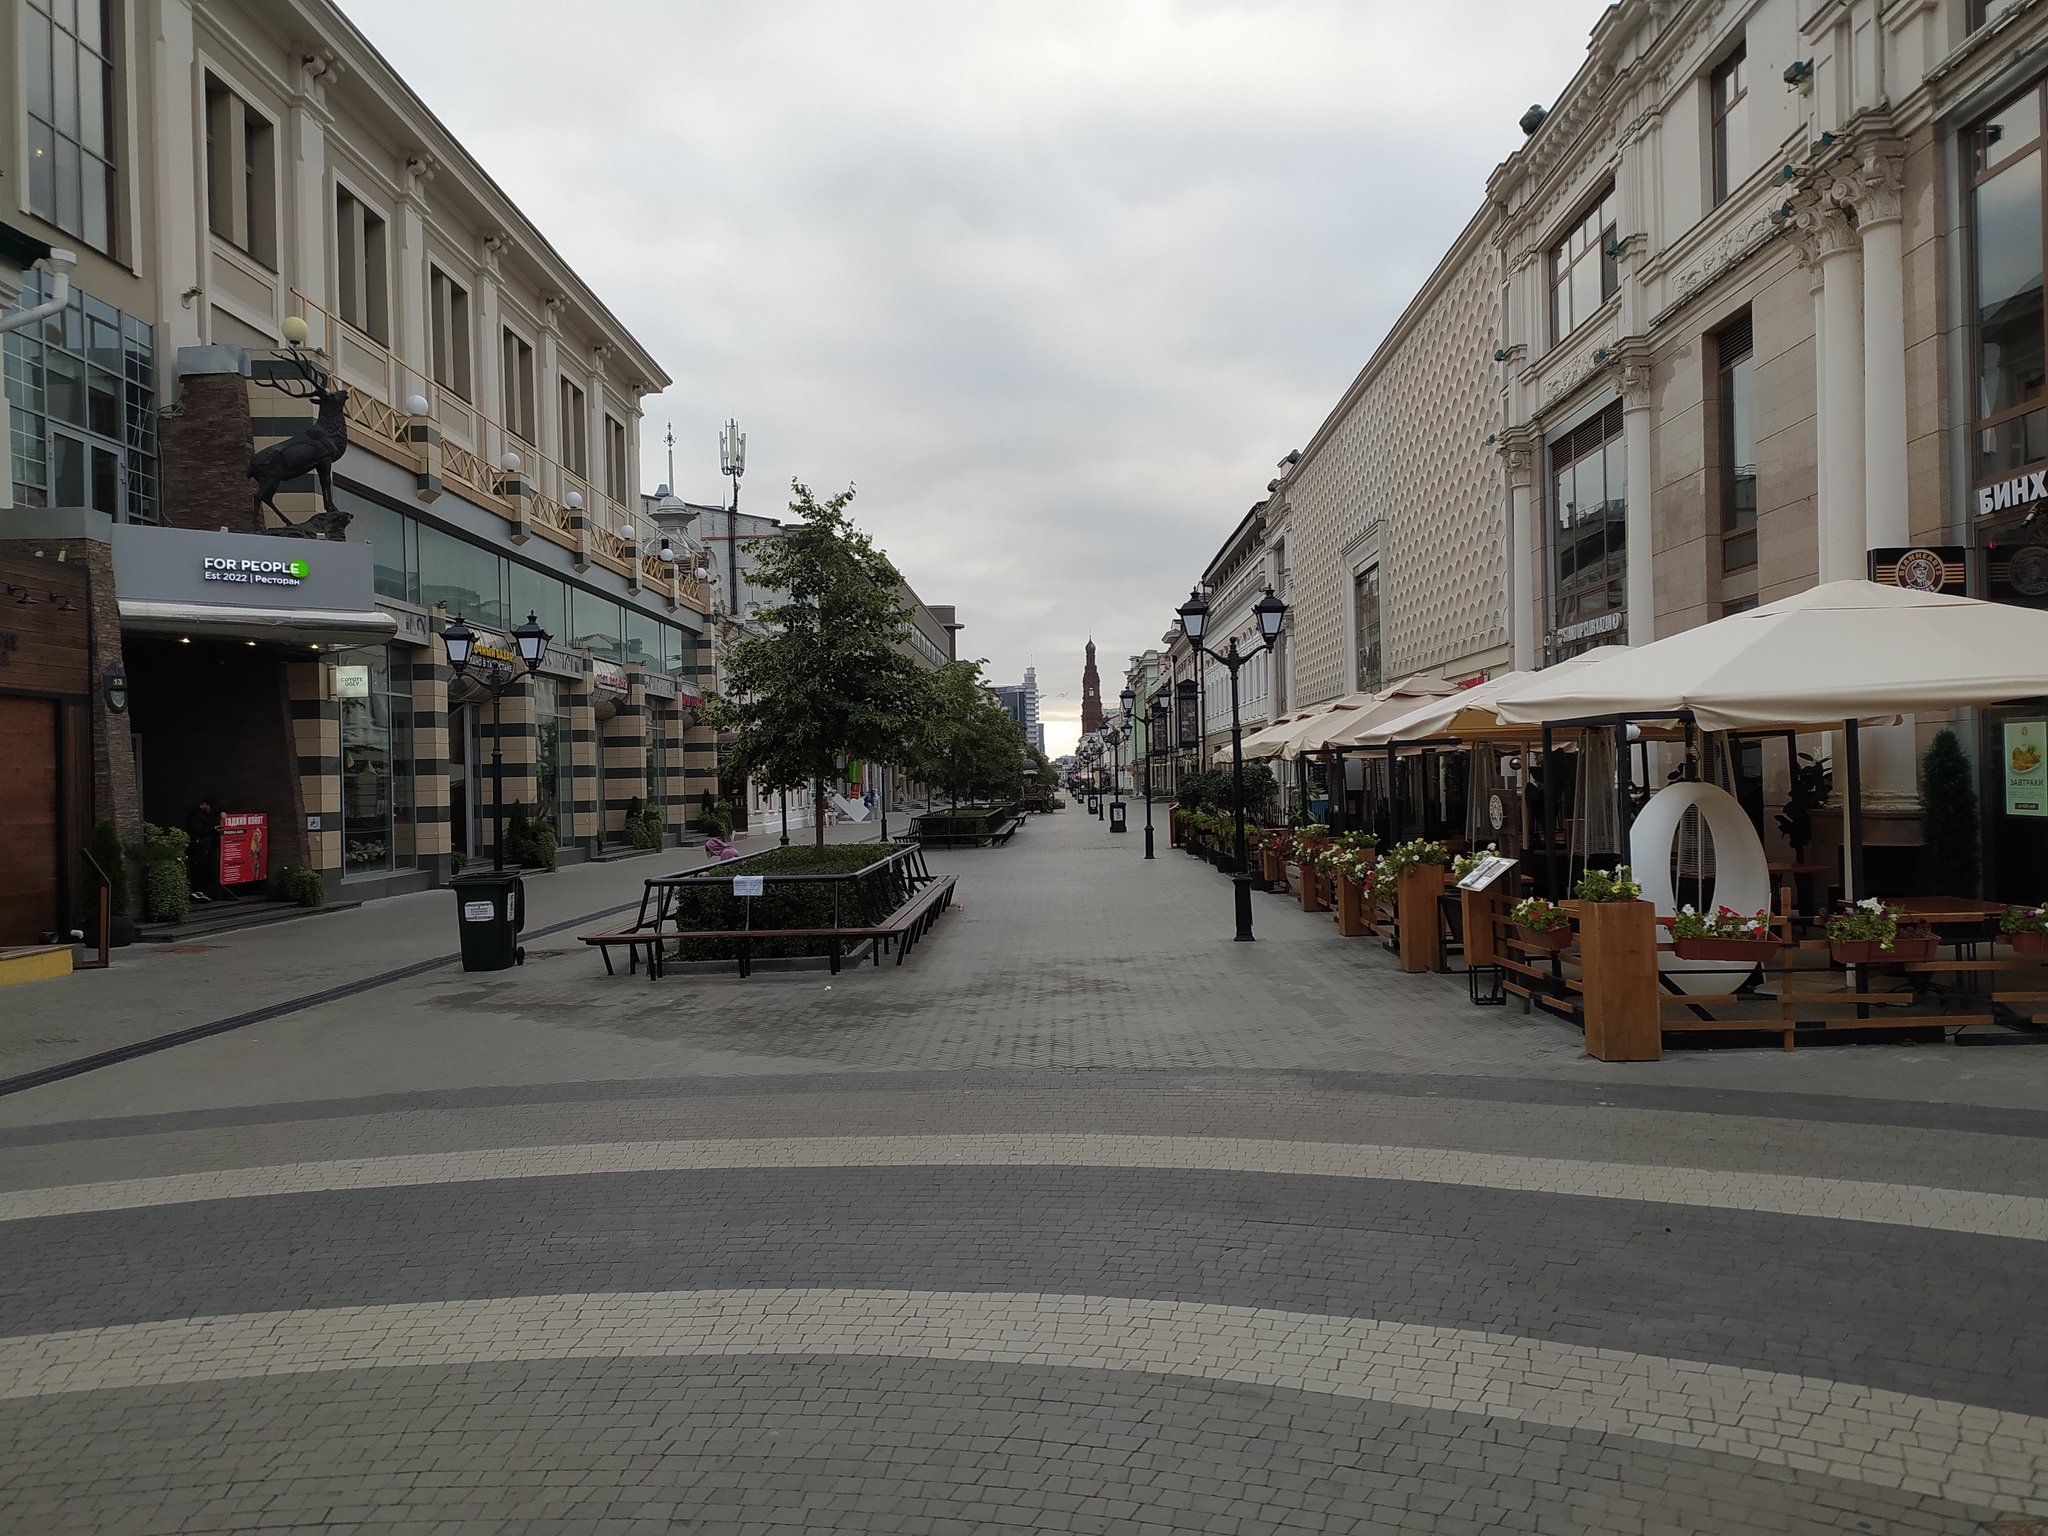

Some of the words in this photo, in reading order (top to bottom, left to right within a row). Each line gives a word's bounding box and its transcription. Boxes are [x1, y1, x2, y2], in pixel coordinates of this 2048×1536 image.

[205, 558, 237, 570] FOR
[241, 560, 300, 574] PEOPLE
[1899, 553, 1942, 575] BEANHEARTS
[205, 572, 221, 580] Est
[223, 573, 247, 582] 2022
[255, 575, 300, 585] Ресторан
[474, 644, 496, 658] ОЧНЫЙ
[2010, 791, 2025, 799] ВЕСЬ
[2026, 791, 2044, 799] ДЕНЬ
[225, 815, 247, 827] ГАДКИЙ
[248, 815, 263, 825] КОЙОТ
